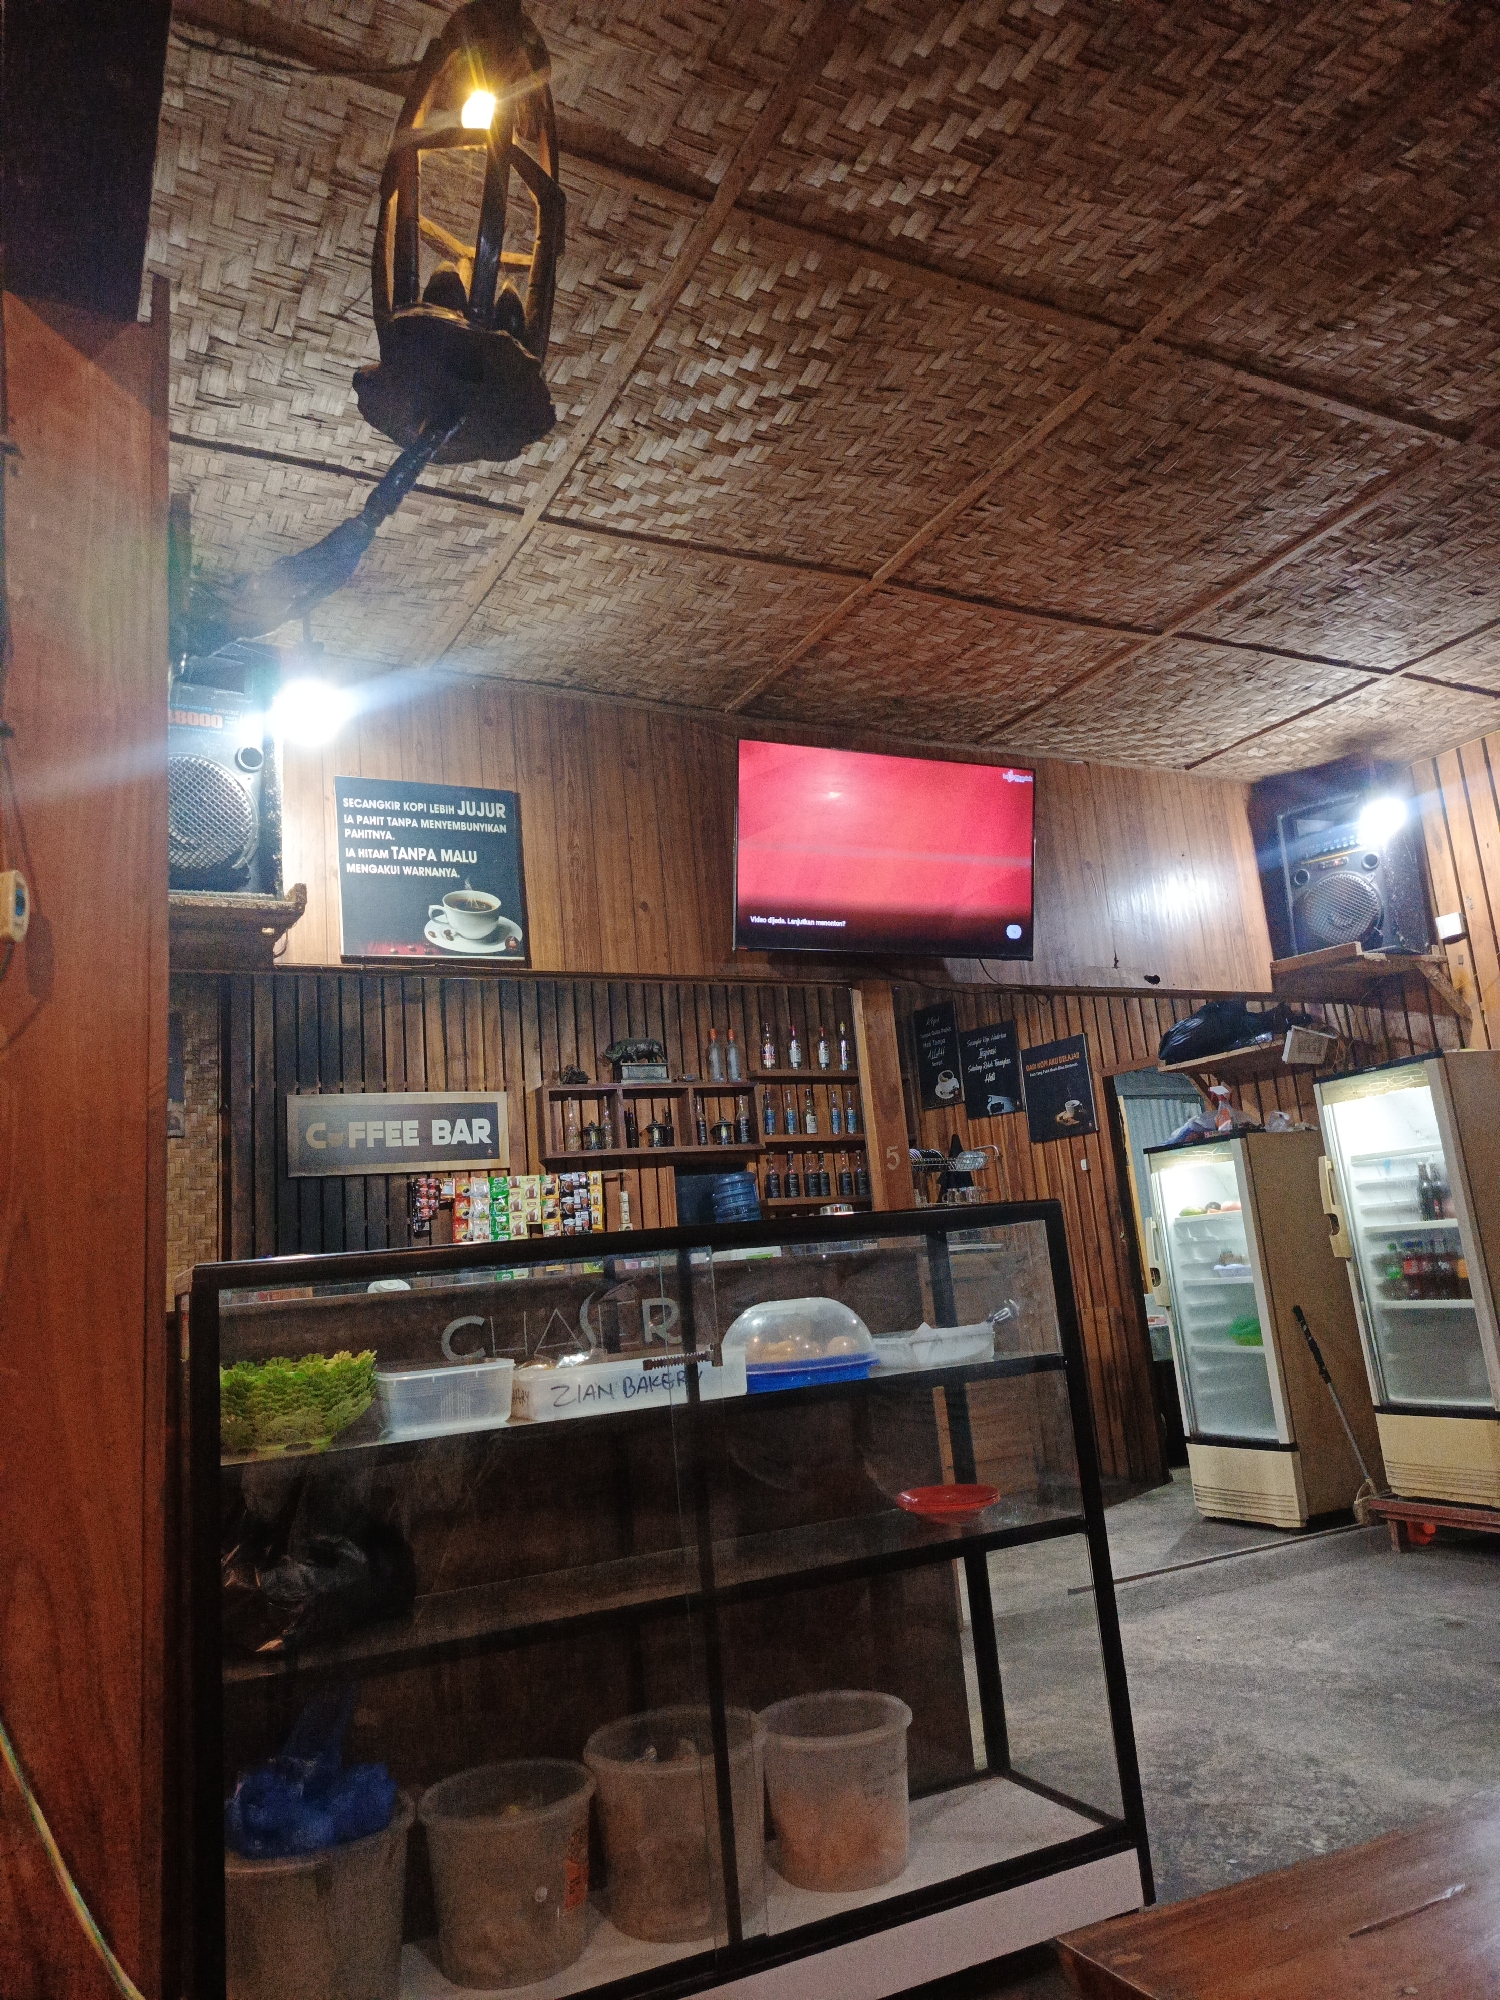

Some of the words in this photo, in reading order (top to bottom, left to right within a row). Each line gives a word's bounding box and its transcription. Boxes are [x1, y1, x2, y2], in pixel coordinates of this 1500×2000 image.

[343, 798, 400, 810] SECANGKIR
[403, 801, 427, 813] KOPI
[429, 804, 455, 815] LEBIH
[457, 801, 506, 818] JUJUR
[344, 814, 354, 824] IA
[356, 815, 384, 826] PAHIT
[387, 817, 418, 828] TANPA
[420, 819, 507, 834] MENYEMBUNYIKAN
[344, 829, 395, 841] PAHITNYA.
[345, 848, 356, 858] IA
[358, 848, 389, 859] HITAM
[390, 846, 437, 862] TANPA
[441, 849, 477, 864] MALU
[346, 863, 400, 875] MENGAKUI
[402, 865, 460, 878] WARNANYA.
[749, 915, 766, 923] Video
[787, 917, 815, 926] Lanjutkan
[815, 919, 846, 927] menonton?
[431, 1118, 493, 1146] BAR
[886, 1145, 901, 1171] 5
[551, 1384, 615, 1407] ZIAN
